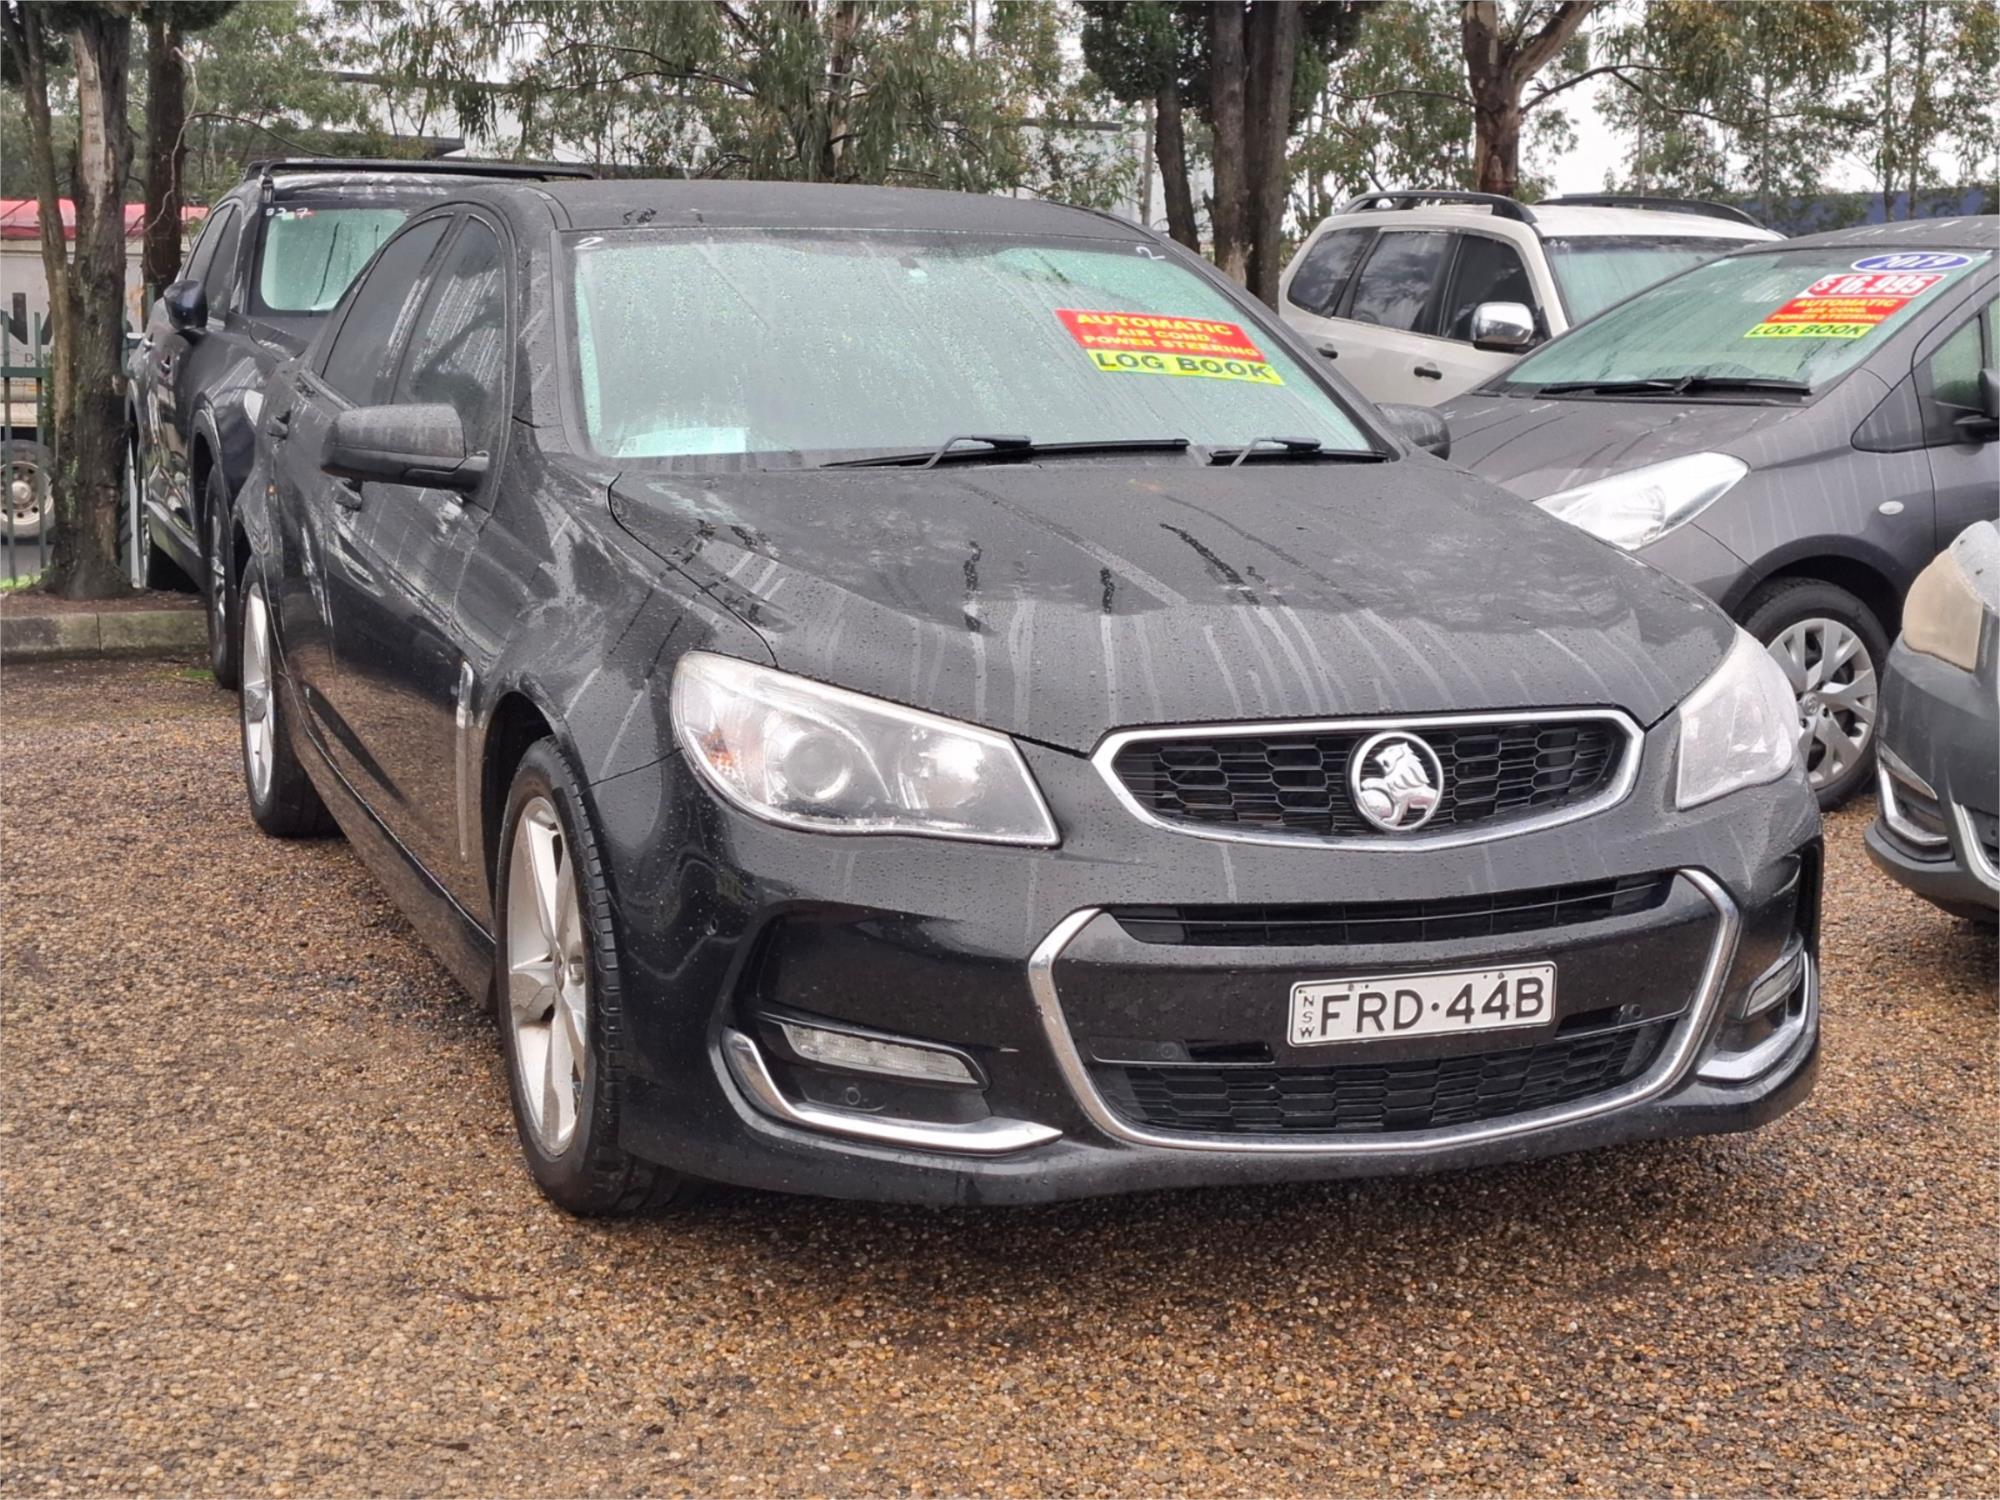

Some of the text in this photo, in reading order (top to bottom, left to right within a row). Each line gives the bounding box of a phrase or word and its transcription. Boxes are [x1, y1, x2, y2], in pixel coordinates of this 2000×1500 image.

[1865, 255, 1958, 269] 2019
[1793, 298, 1899, 307] AUTOMATIC
[1077, 313, 1233, 336] AUTOMATIC
[1750, 324, 1867, 336] LOG BOOK
[1116, 326, 1150, 338] AIR
[1083, 335, 1260, 358] POWER STEERING
[1096, 352, 1272, 380] LOG BOOK
